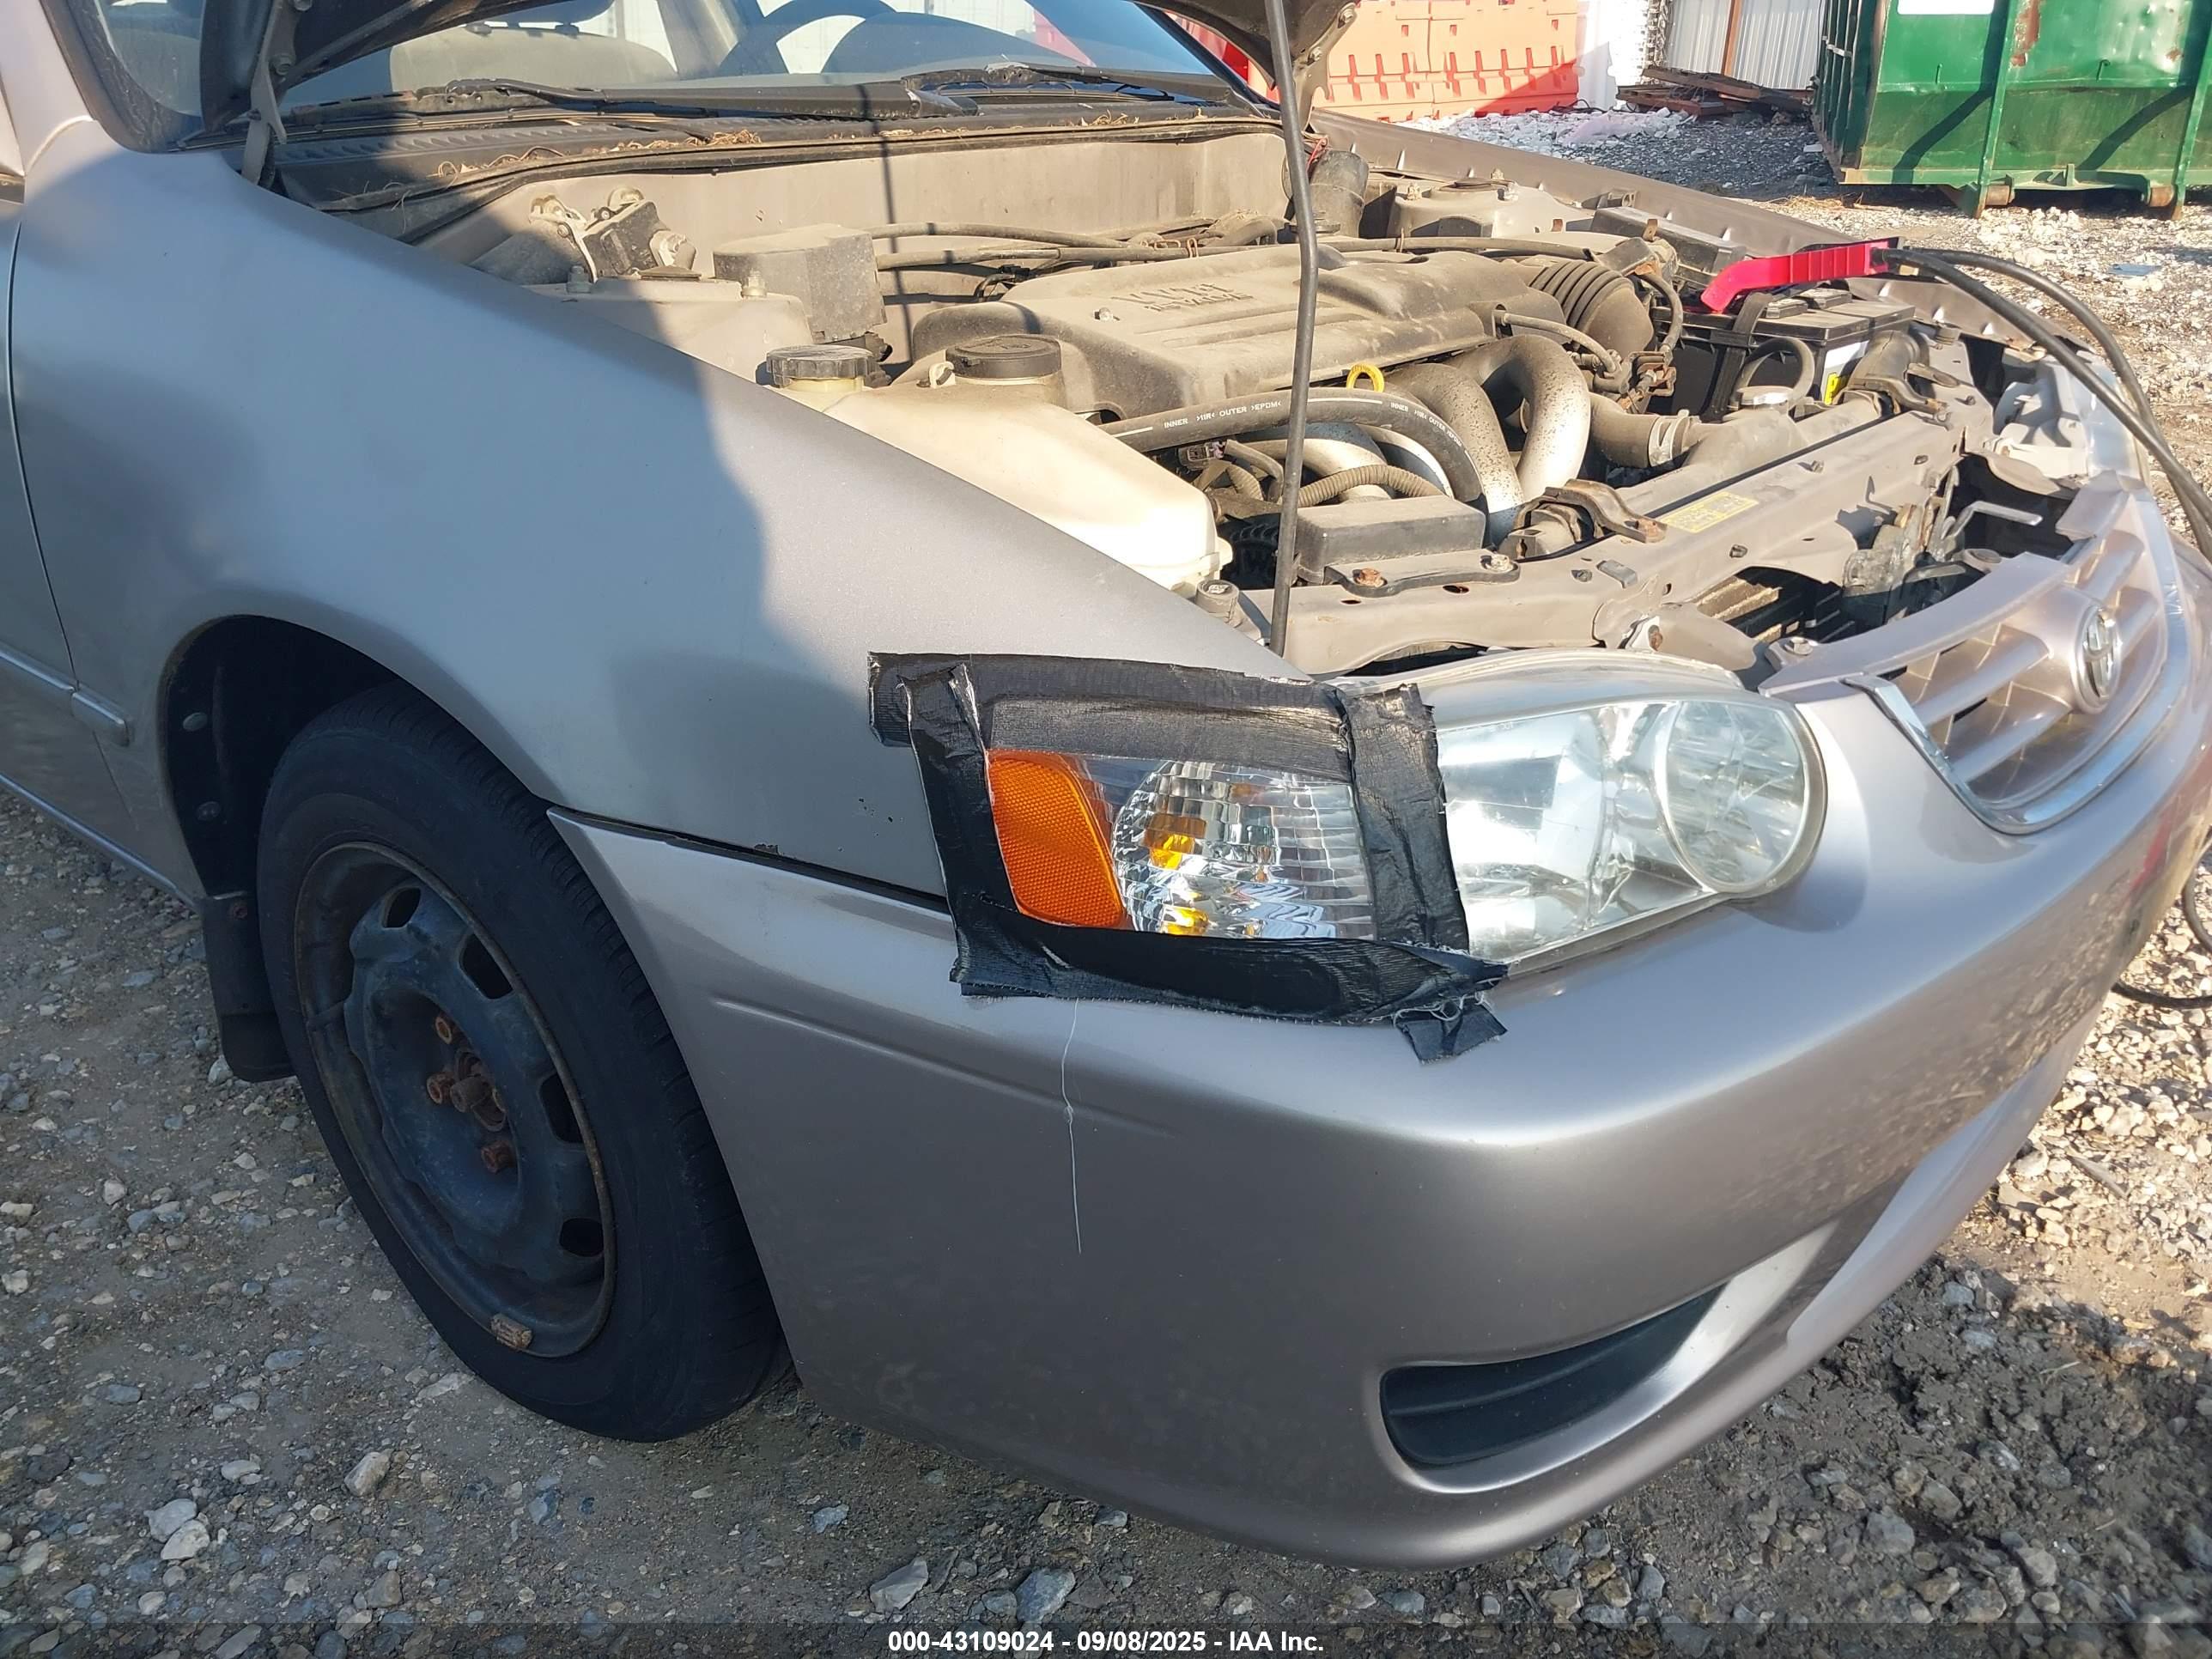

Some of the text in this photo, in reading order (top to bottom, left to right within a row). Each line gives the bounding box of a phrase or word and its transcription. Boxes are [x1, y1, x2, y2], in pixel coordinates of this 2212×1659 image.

[1164, 417, 1189, 429] INNER
[1218, 405, 1248, 418] OUTER
[1428, 416, 1446, 432] OUTER
